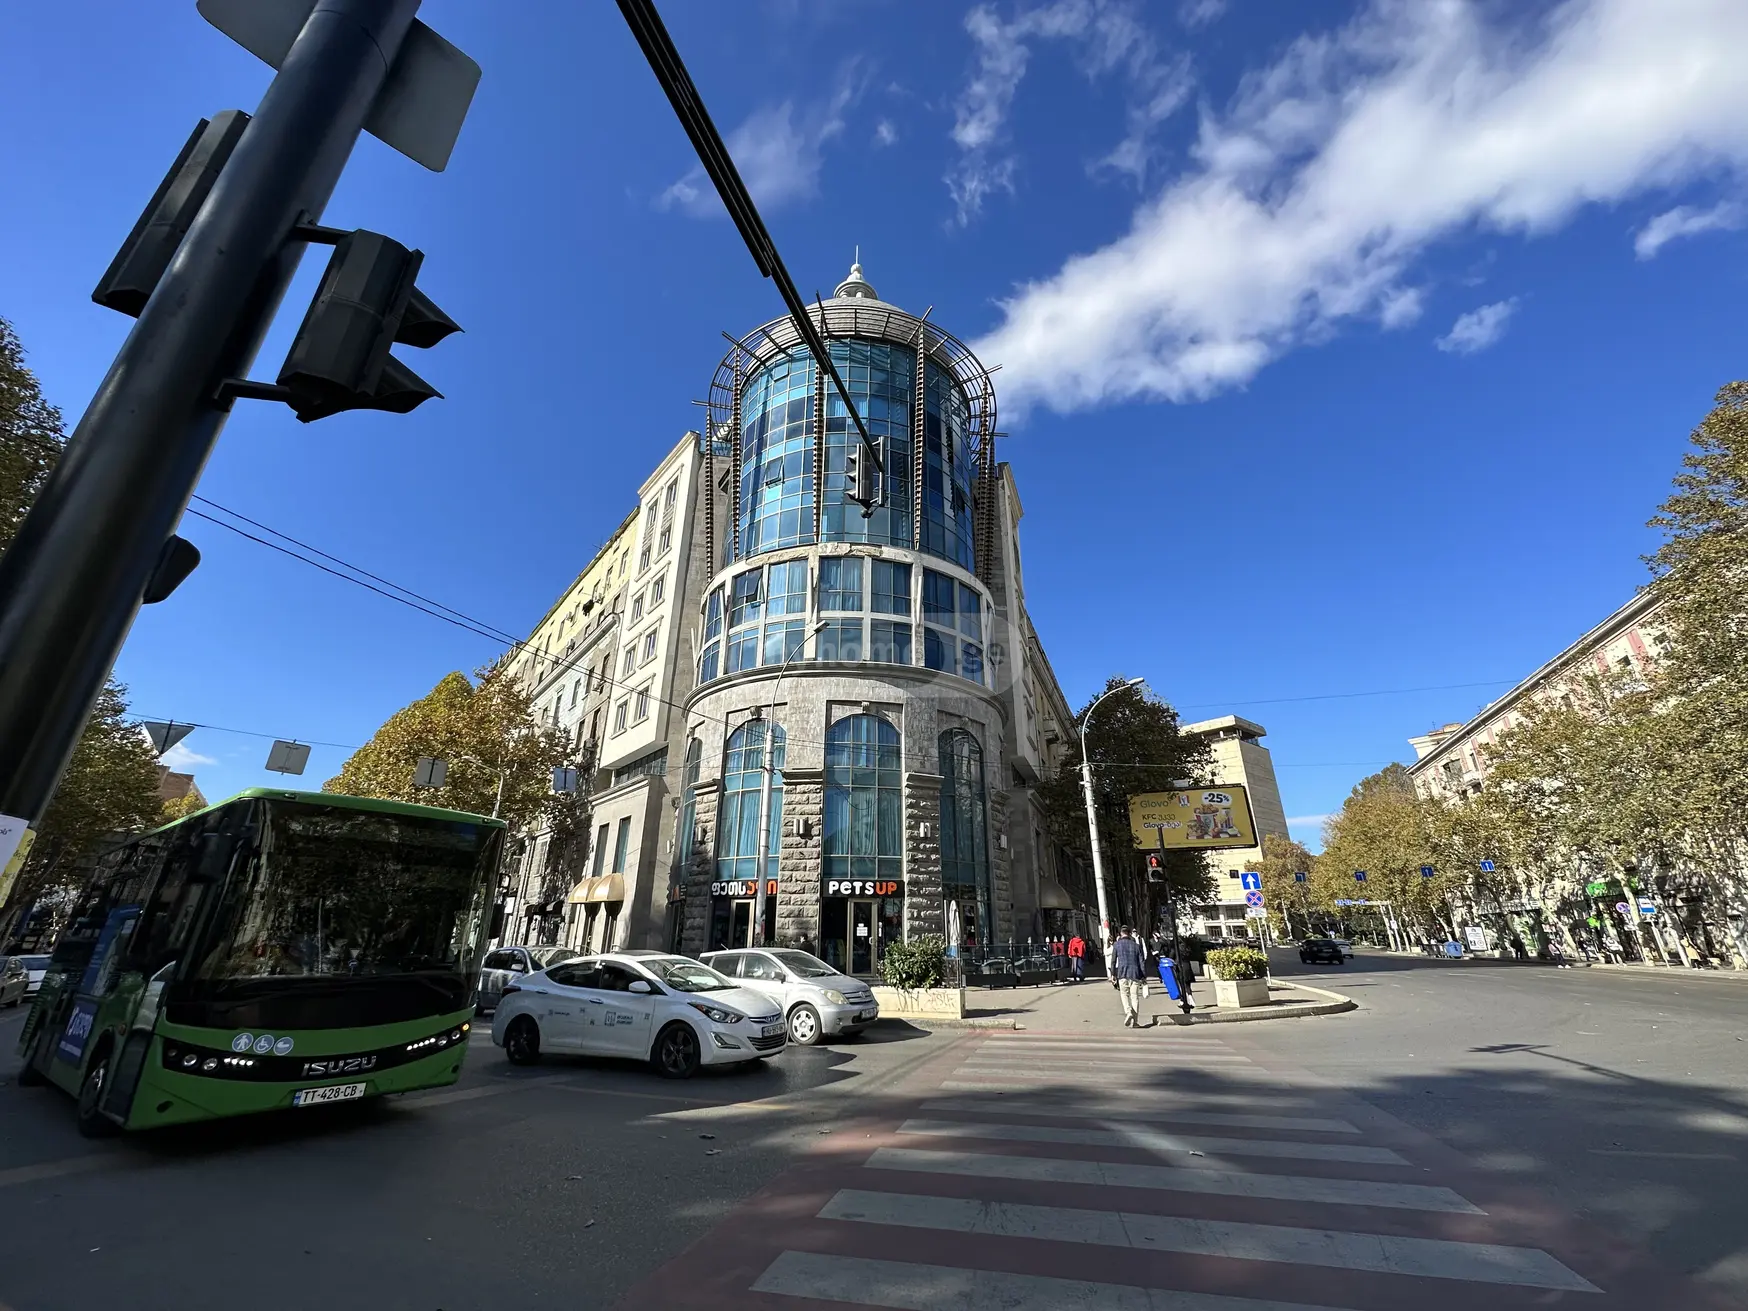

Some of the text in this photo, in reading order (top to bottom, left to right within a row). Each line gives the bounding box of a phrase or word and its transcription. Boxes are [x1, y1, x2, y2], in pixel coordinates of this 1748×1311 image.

[1140, 800, 1169, 809] Glovo
[1204, 792, 1230, 804] -25%
[1142, 813, 1157, 821] KFC
[711, 880, 777, 896] ფეთსაი
[301, 1055, 377, 1078] ISUZU
[303, 1085, 358, 1103] TT-428-CB
